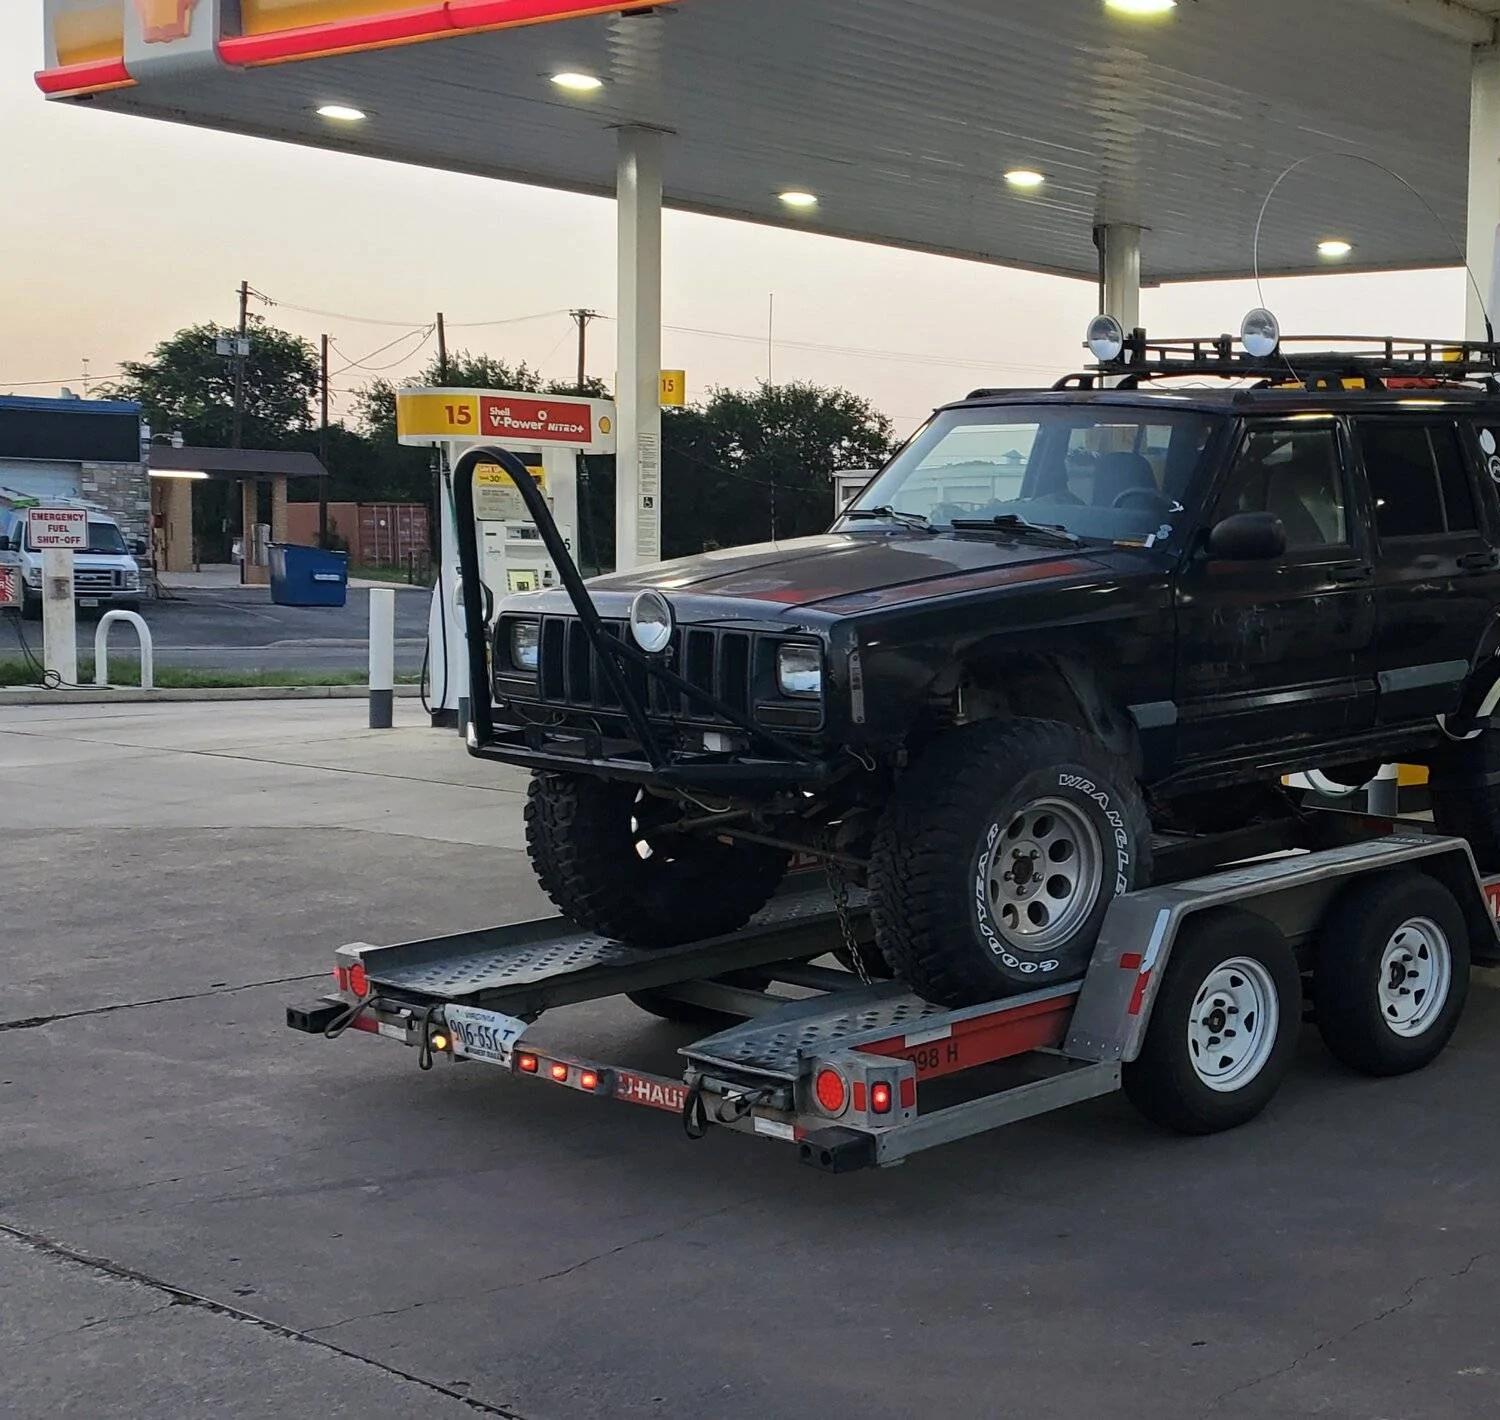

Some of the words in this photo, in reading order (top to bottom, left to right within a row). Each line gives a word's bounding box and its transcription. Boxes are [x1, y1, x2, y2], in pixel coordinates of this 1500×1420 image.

[662, 379, 674, 393] 15
[445, 405, 472, 426] 15
[490, 407, 510, 416] Shell
[490, 416, 545, 430] V-Power
[31, 513, 84, 521] EMERGENCY
[37, 536, 81, 544] SHUT-OFF
[975, 823, 1060, 973] GOODYEAR
